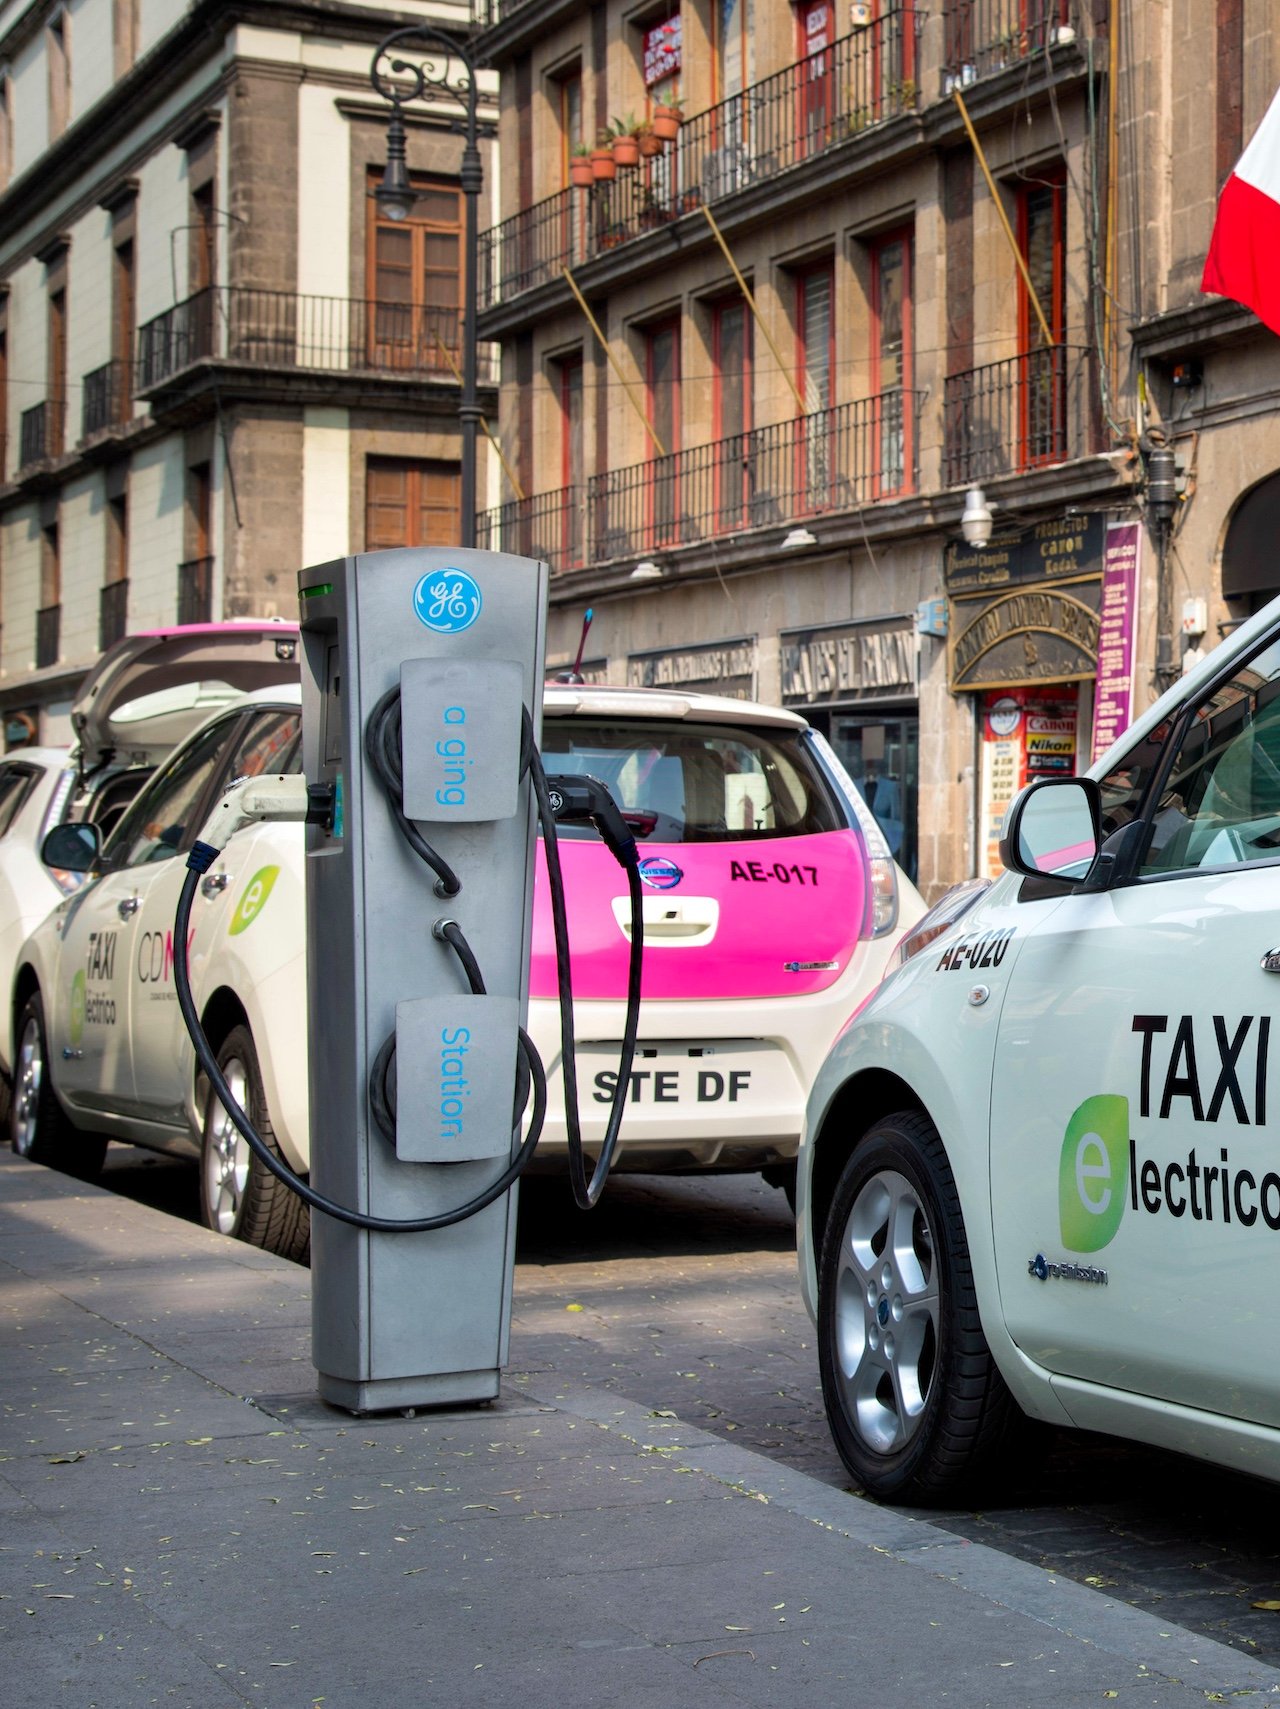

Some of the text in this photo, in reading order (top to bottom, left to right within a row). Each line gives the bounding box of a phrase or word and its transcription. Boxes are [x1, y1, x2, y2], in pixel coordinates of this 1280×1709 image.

[1029, 718, 1074, 734] Canon
[1030, 739, 1073, 752] Nikon
[730, 860, 819, 886] AE-017
[87, 931, 118, 980] TAXI
[935, 926, 1018, 972] AE-020
[592, 1070, 752, 1103] STE DF
[1131, 1014, 1271, 1126] TAXI
